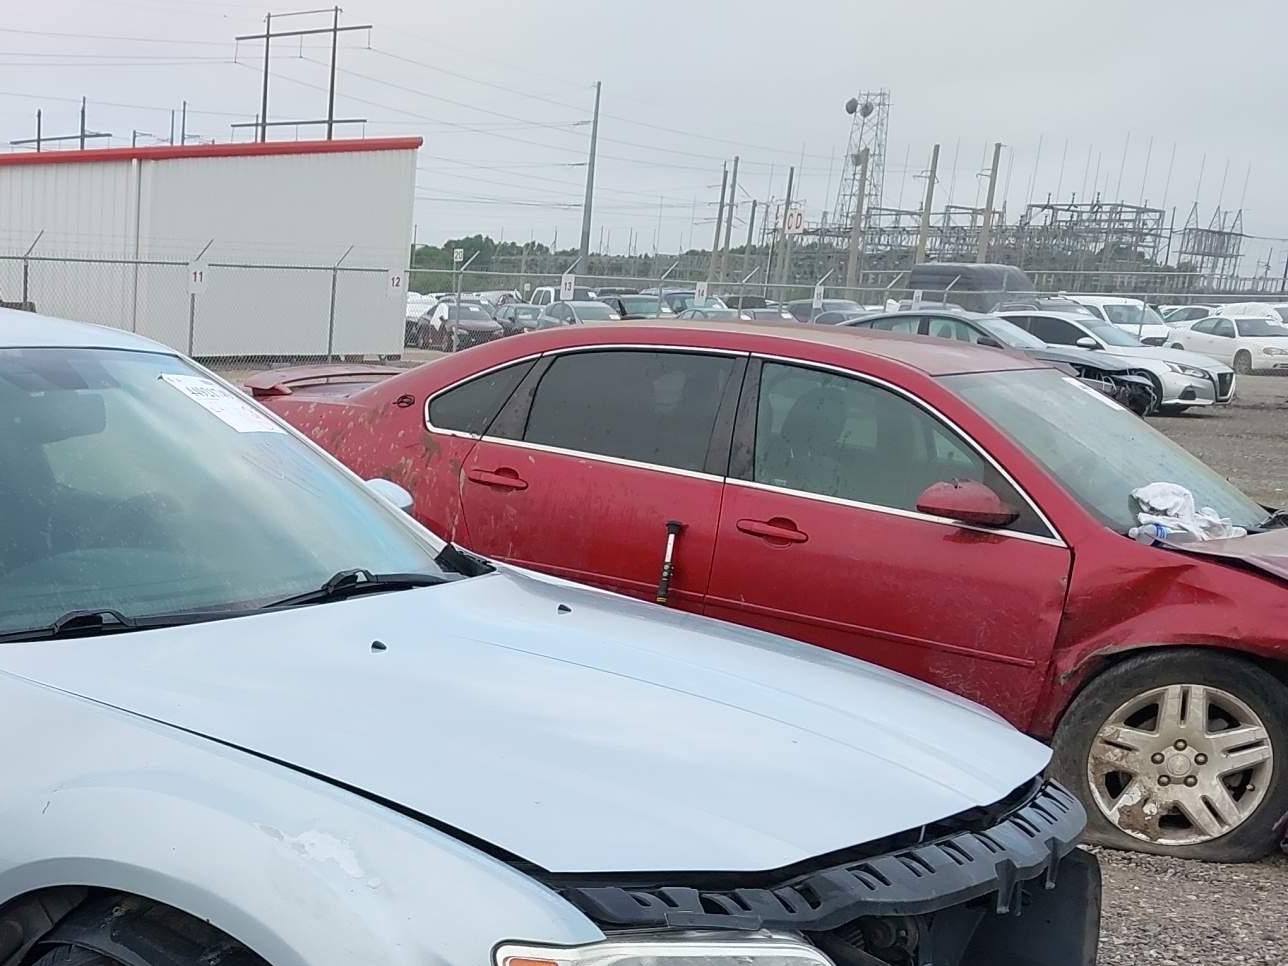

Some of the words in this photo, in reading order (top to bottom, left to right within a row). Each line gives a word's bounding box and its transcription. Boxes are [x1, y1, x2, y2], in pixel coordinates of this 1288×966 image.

[193, 271, 203, 282] 11
[392, 276, 401, 287] 12
[564, 281, 572, 292] 13
